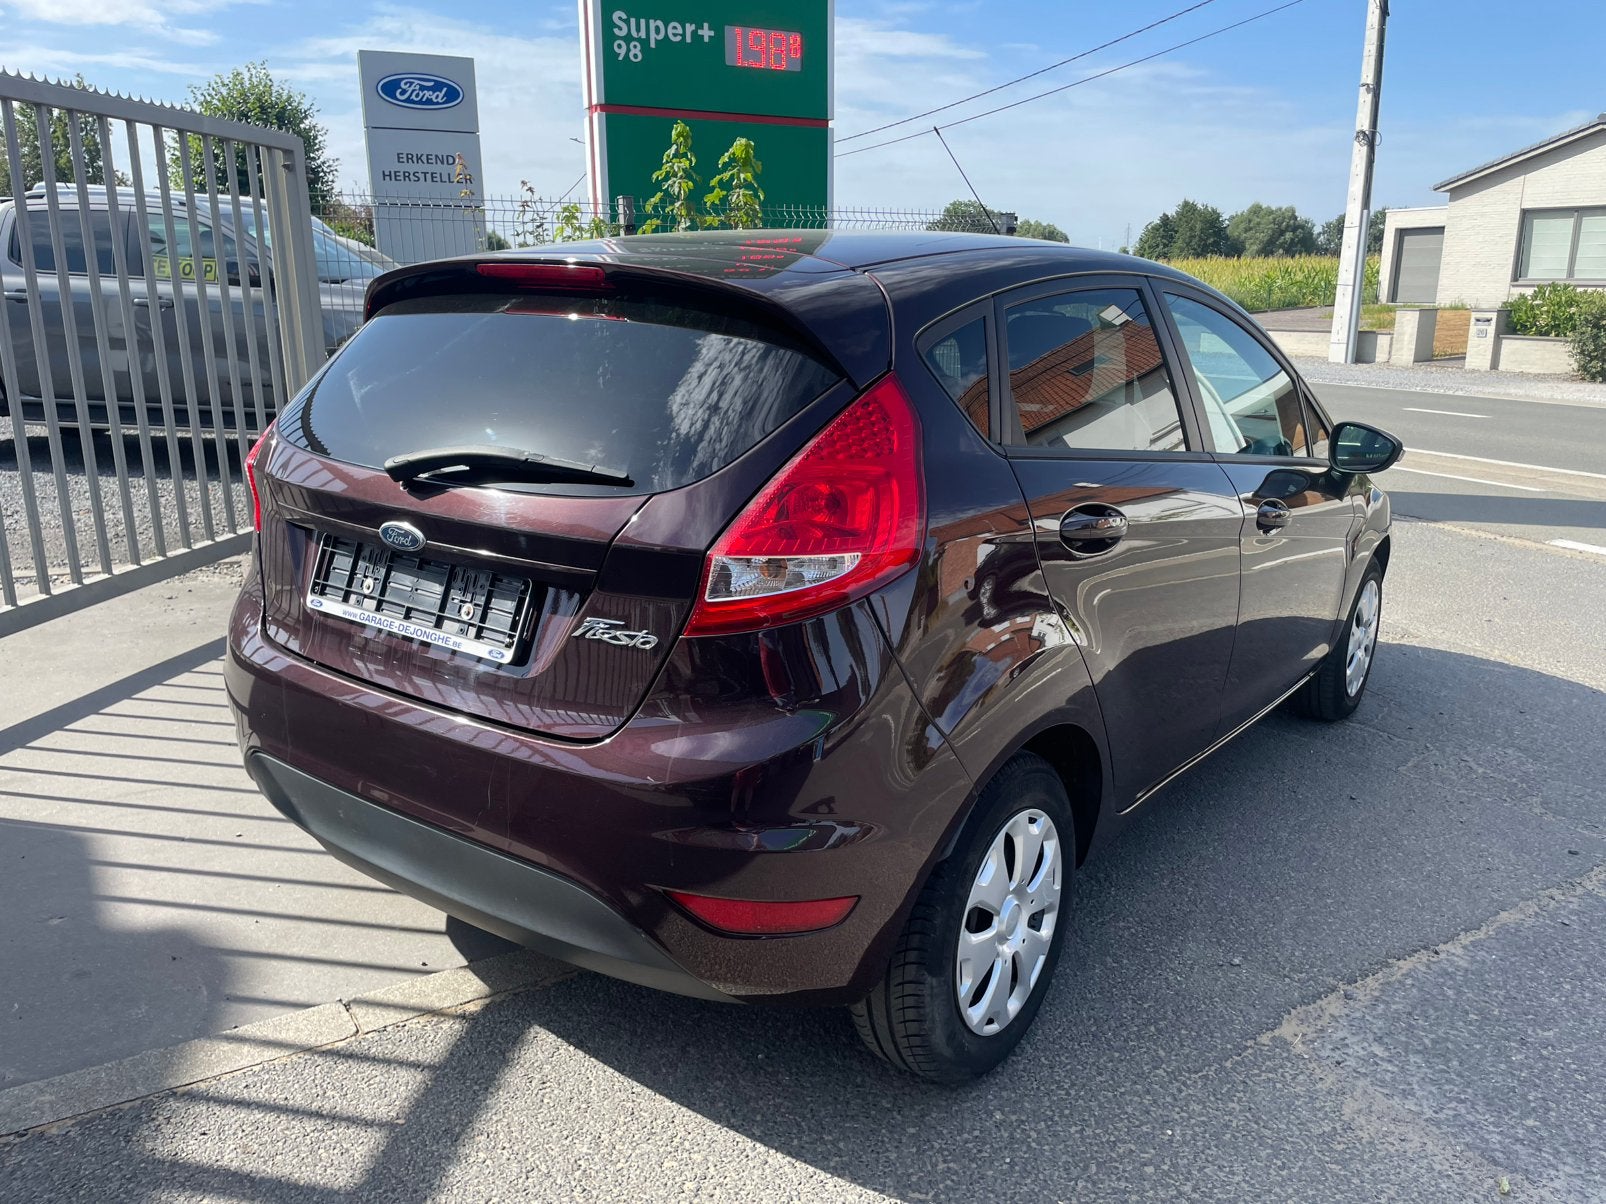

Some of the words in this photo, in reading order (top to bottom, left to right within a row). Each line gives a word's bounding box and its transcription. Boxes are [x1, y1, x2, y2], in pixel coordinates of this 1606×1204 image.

[612, 10, 714, 48] Super+
[613, 39, 642, 62] 98
[396, 79, 447, 102] Ford
[397, 152, 456, 166] ERKEND
[342, 608, 463, 649] www.GARAGE-DEJONGHE.BE
[571, 617, 659, 650] Fiesta
